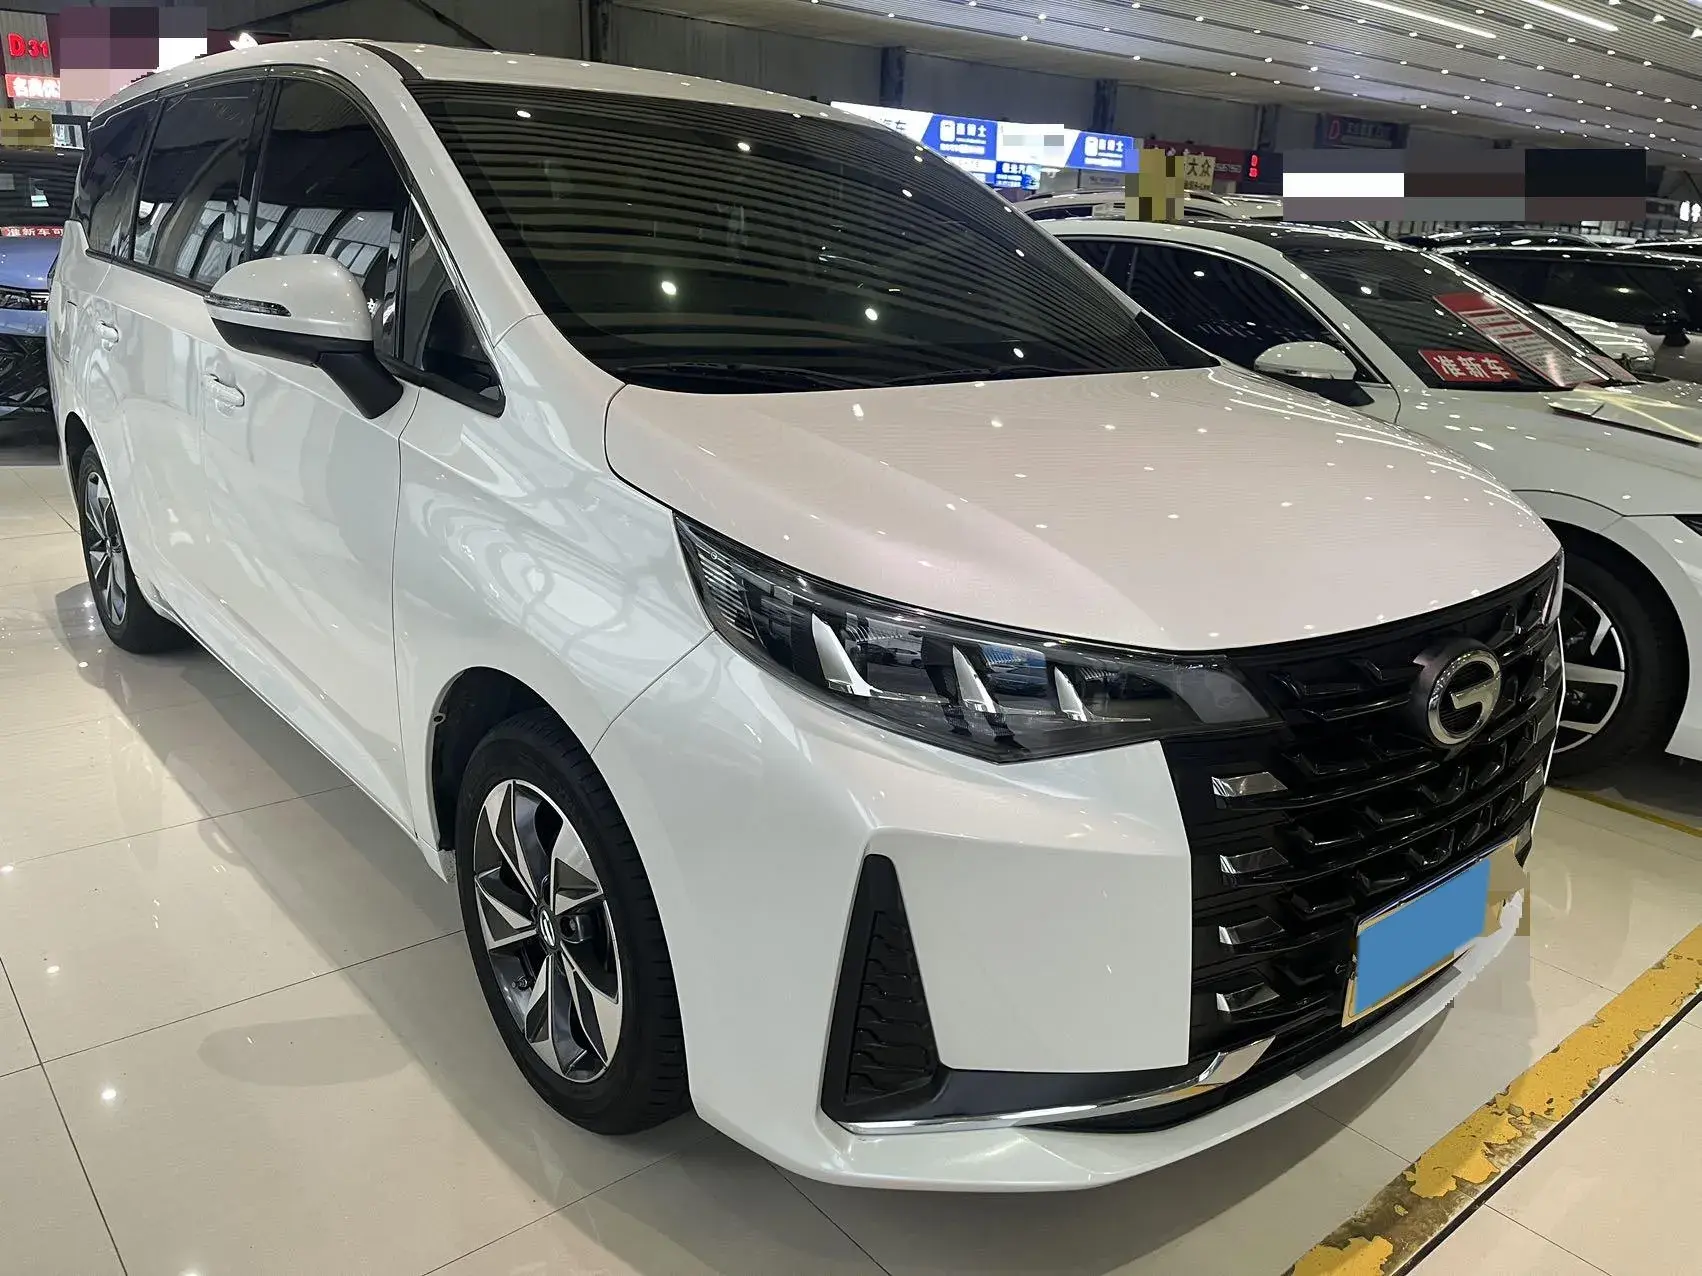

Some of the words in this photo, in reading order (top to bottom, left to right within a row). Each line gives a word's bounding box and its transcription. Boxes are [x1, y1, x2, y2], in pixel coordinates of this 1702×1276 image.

[7, 32, 49, 58] D31
[1433, 354, 1511, 379] 准新车
